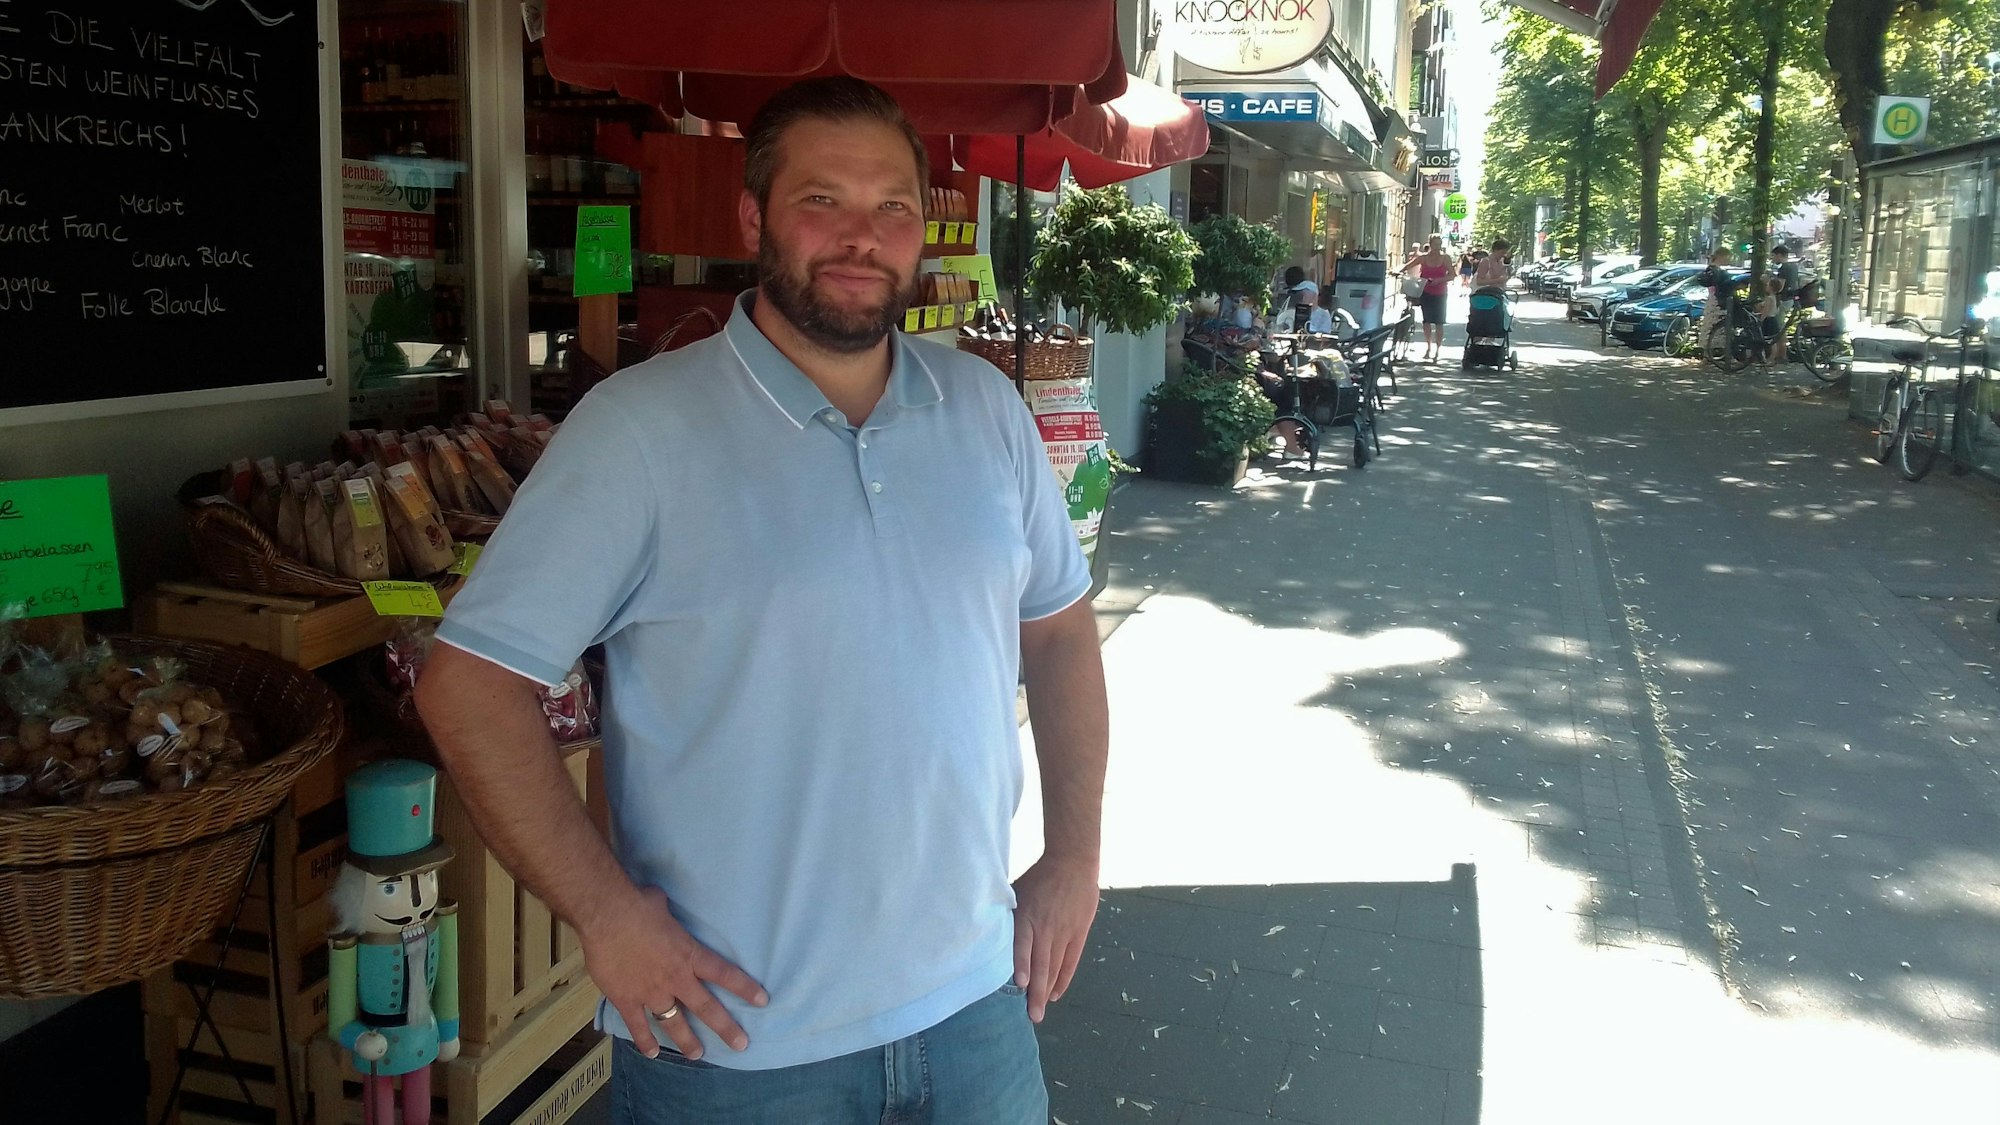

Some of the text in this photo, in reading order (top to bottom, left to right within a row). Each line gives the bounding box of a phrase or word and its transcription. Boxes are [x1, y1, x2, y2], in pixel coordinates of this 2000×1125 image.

[1175, 0, 1315, 23] KNOCKNOK
[46, 10, 114, 51] DIE
[130, 26, 262, 82] VIELFALT
[85, 70, 259, 118] WEINFLUSSES
[1242, 99, 1313, 114] CAFE
[0, 112, 188, 158] ANKREICHS!
[1426, 156, 1448, 166] LOS
[119, 194, 185, 215] Merlot
[1449, 204, 1467, 214] Bio
[62, 214, 129, 243] Franc
[197, 245, 254, 269] Blanc
[81, 283, 227, 319] Folle Blanche
[1050, 454, 1087, 465] ERKAUFSOFFEN
[0, 542, 94, 560] turbelassen
[528, 1054, 605, 1125] Wein aus deutsch
